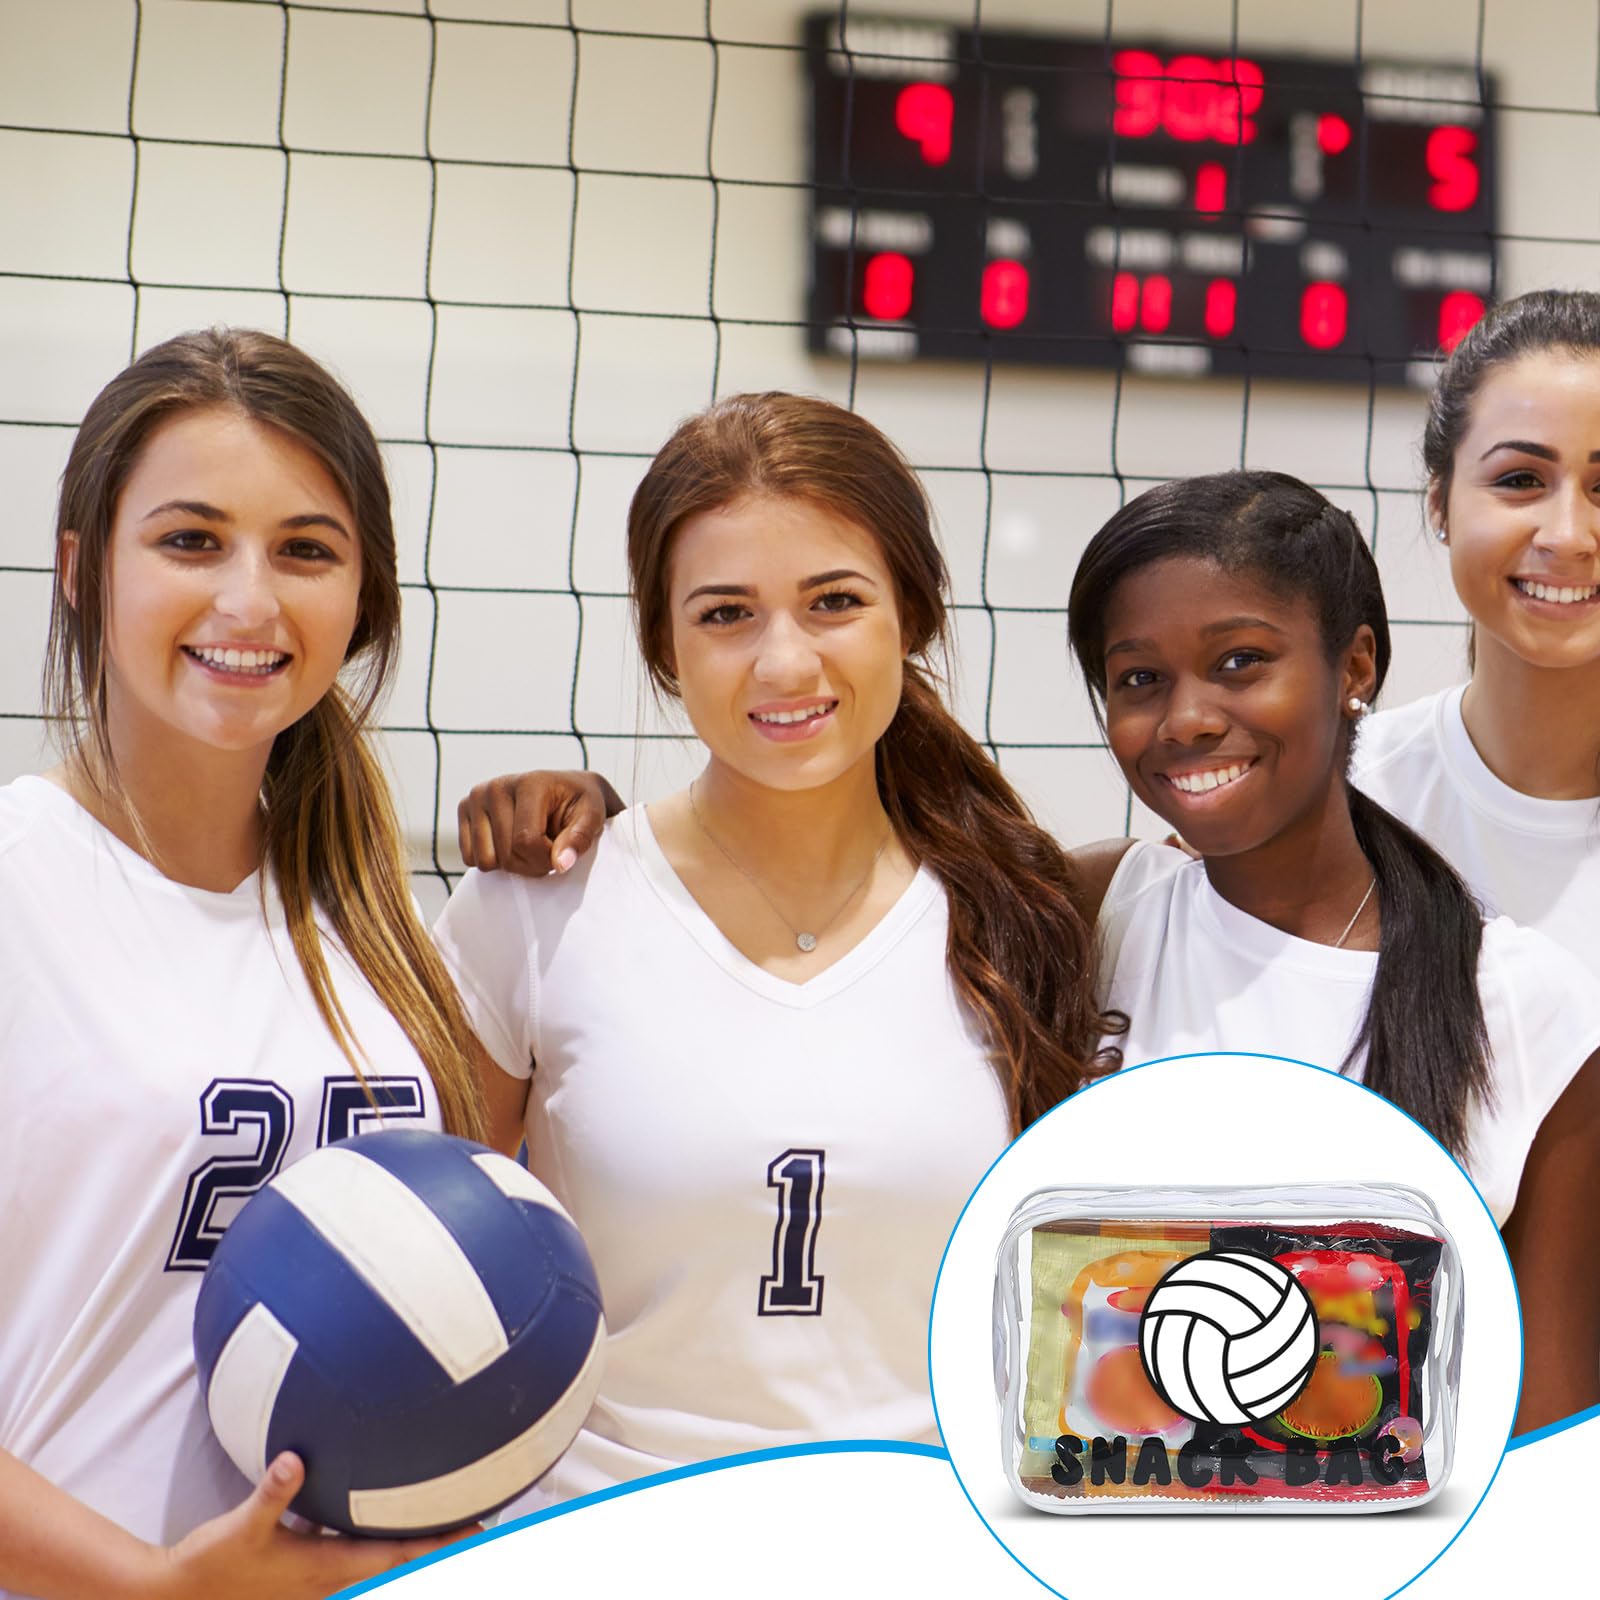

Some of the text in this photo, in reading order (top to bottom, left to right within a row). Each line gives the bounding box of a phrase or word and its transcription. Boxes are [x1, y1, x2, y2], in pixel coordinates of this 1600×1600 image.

[893, 80, 955, 168] 9
[1425, 124, 1481, 213] 5
[979, 258, 1030, 330] 0
[757, 1148, 825, 1317] 1
[1051, 1434, 1405, 1486] SNACK BAG
